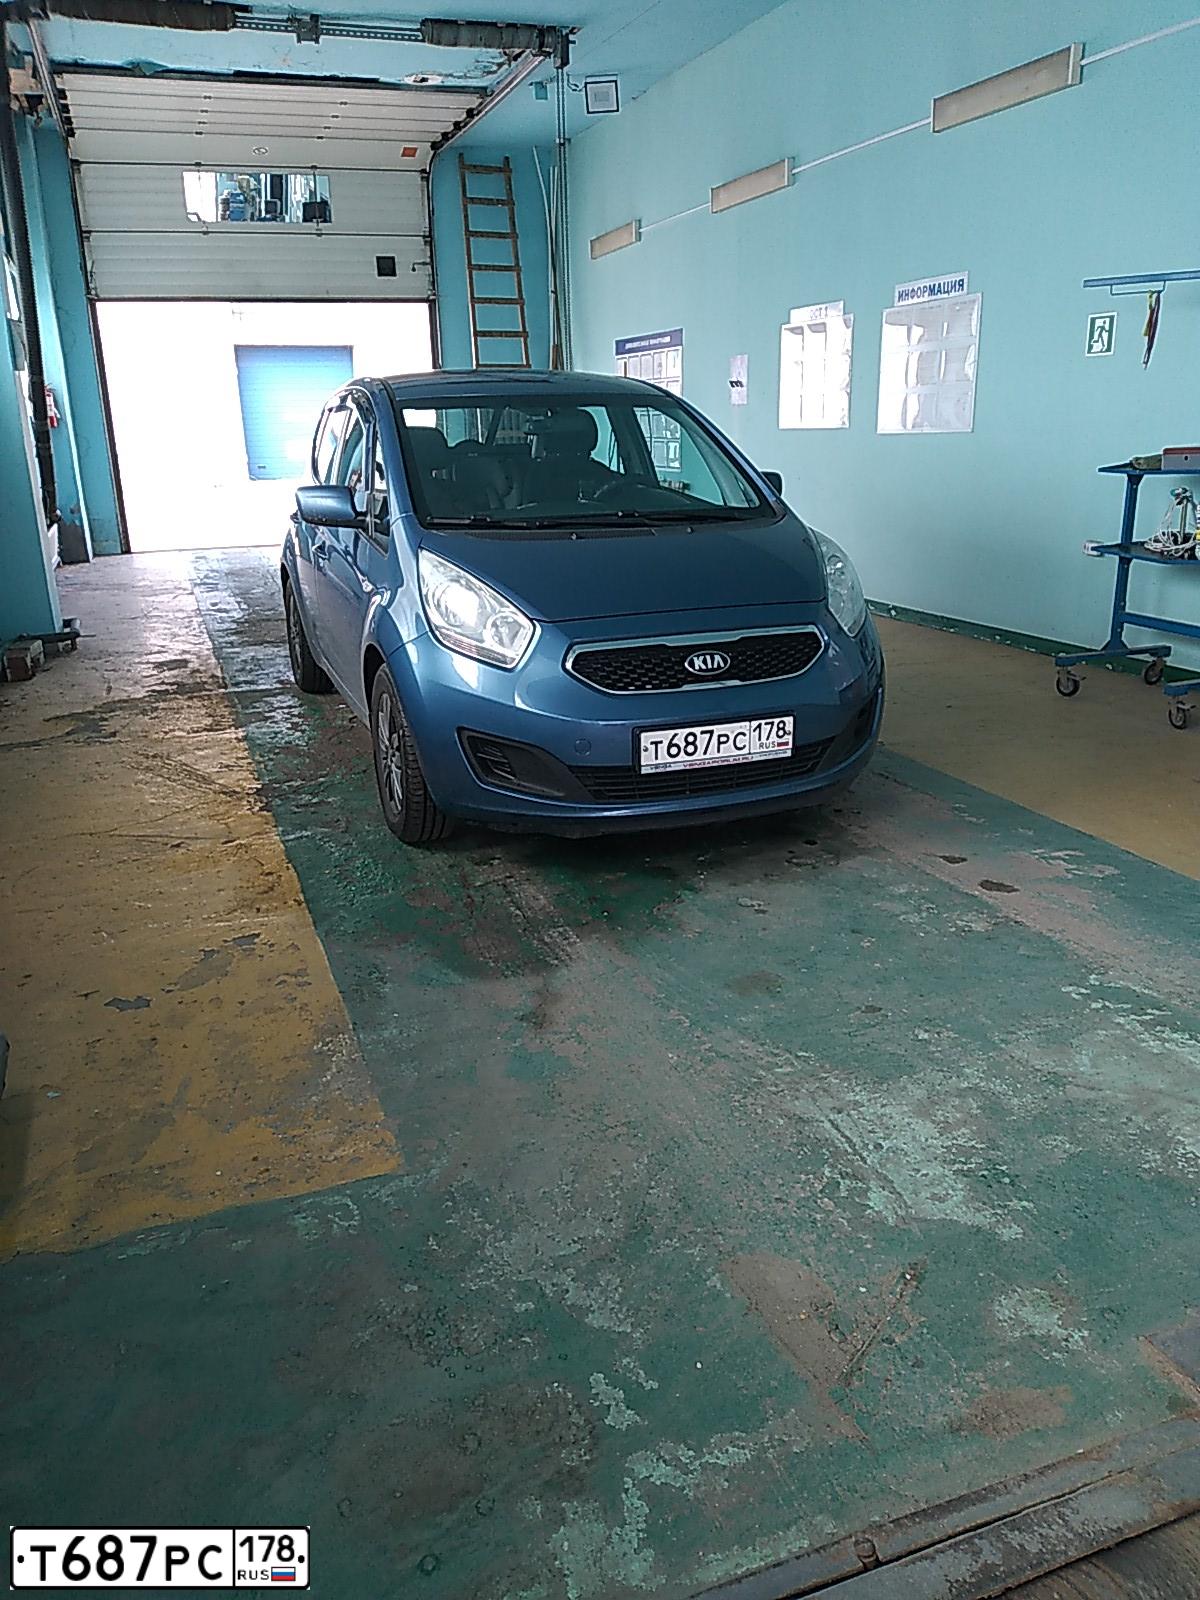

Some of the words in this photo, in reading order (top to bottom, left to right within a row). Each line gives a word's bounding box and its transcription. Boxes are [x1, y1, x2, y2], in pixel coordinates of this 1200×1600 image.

[897, 278, 965, 303] ИНФОРМАЦИЯ
[692, 654, 725, 670] KIA
[752, 719, 787, 742] 178
[758, 740, 776, 750] RUS
